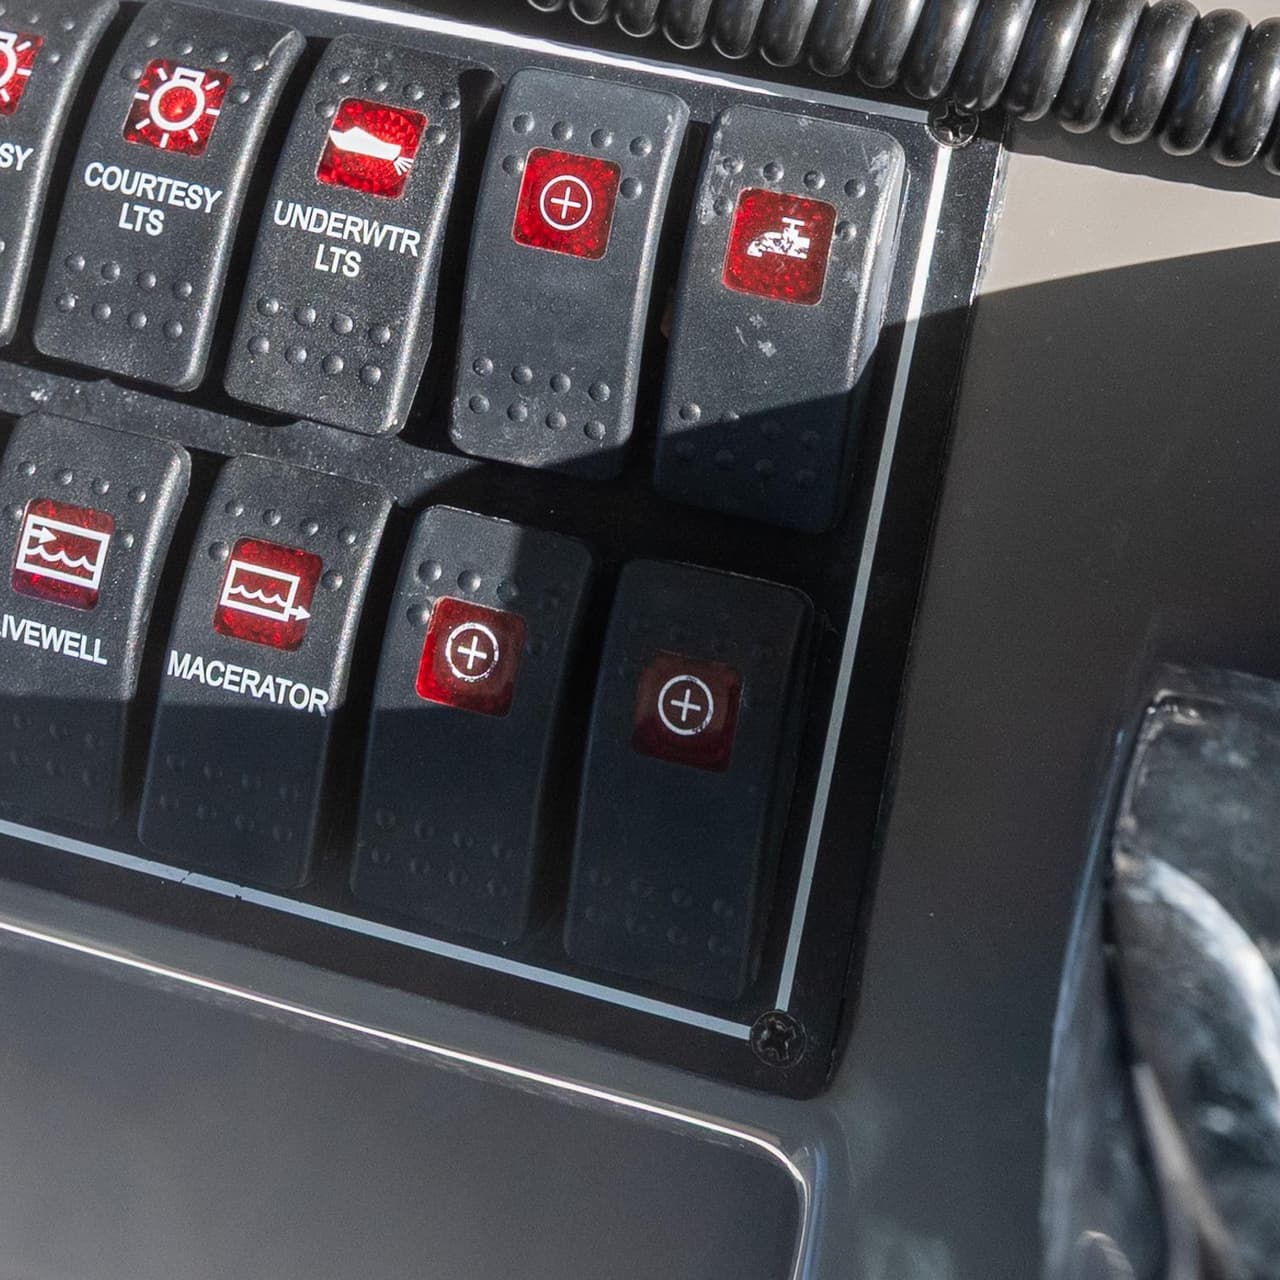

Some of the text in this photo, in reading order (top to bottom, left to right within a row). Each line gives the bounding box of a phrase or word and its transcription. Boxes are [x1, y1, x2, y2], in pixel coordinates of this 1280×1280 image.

[83, 162, 223, 214] COURTESY
[118, 203, 165, 237] LTS
[273, 199, 422, 257] UNDERWTR
[314, 244, 362, 278] LTS
[166, 649, 331, 717] MACERATOR
